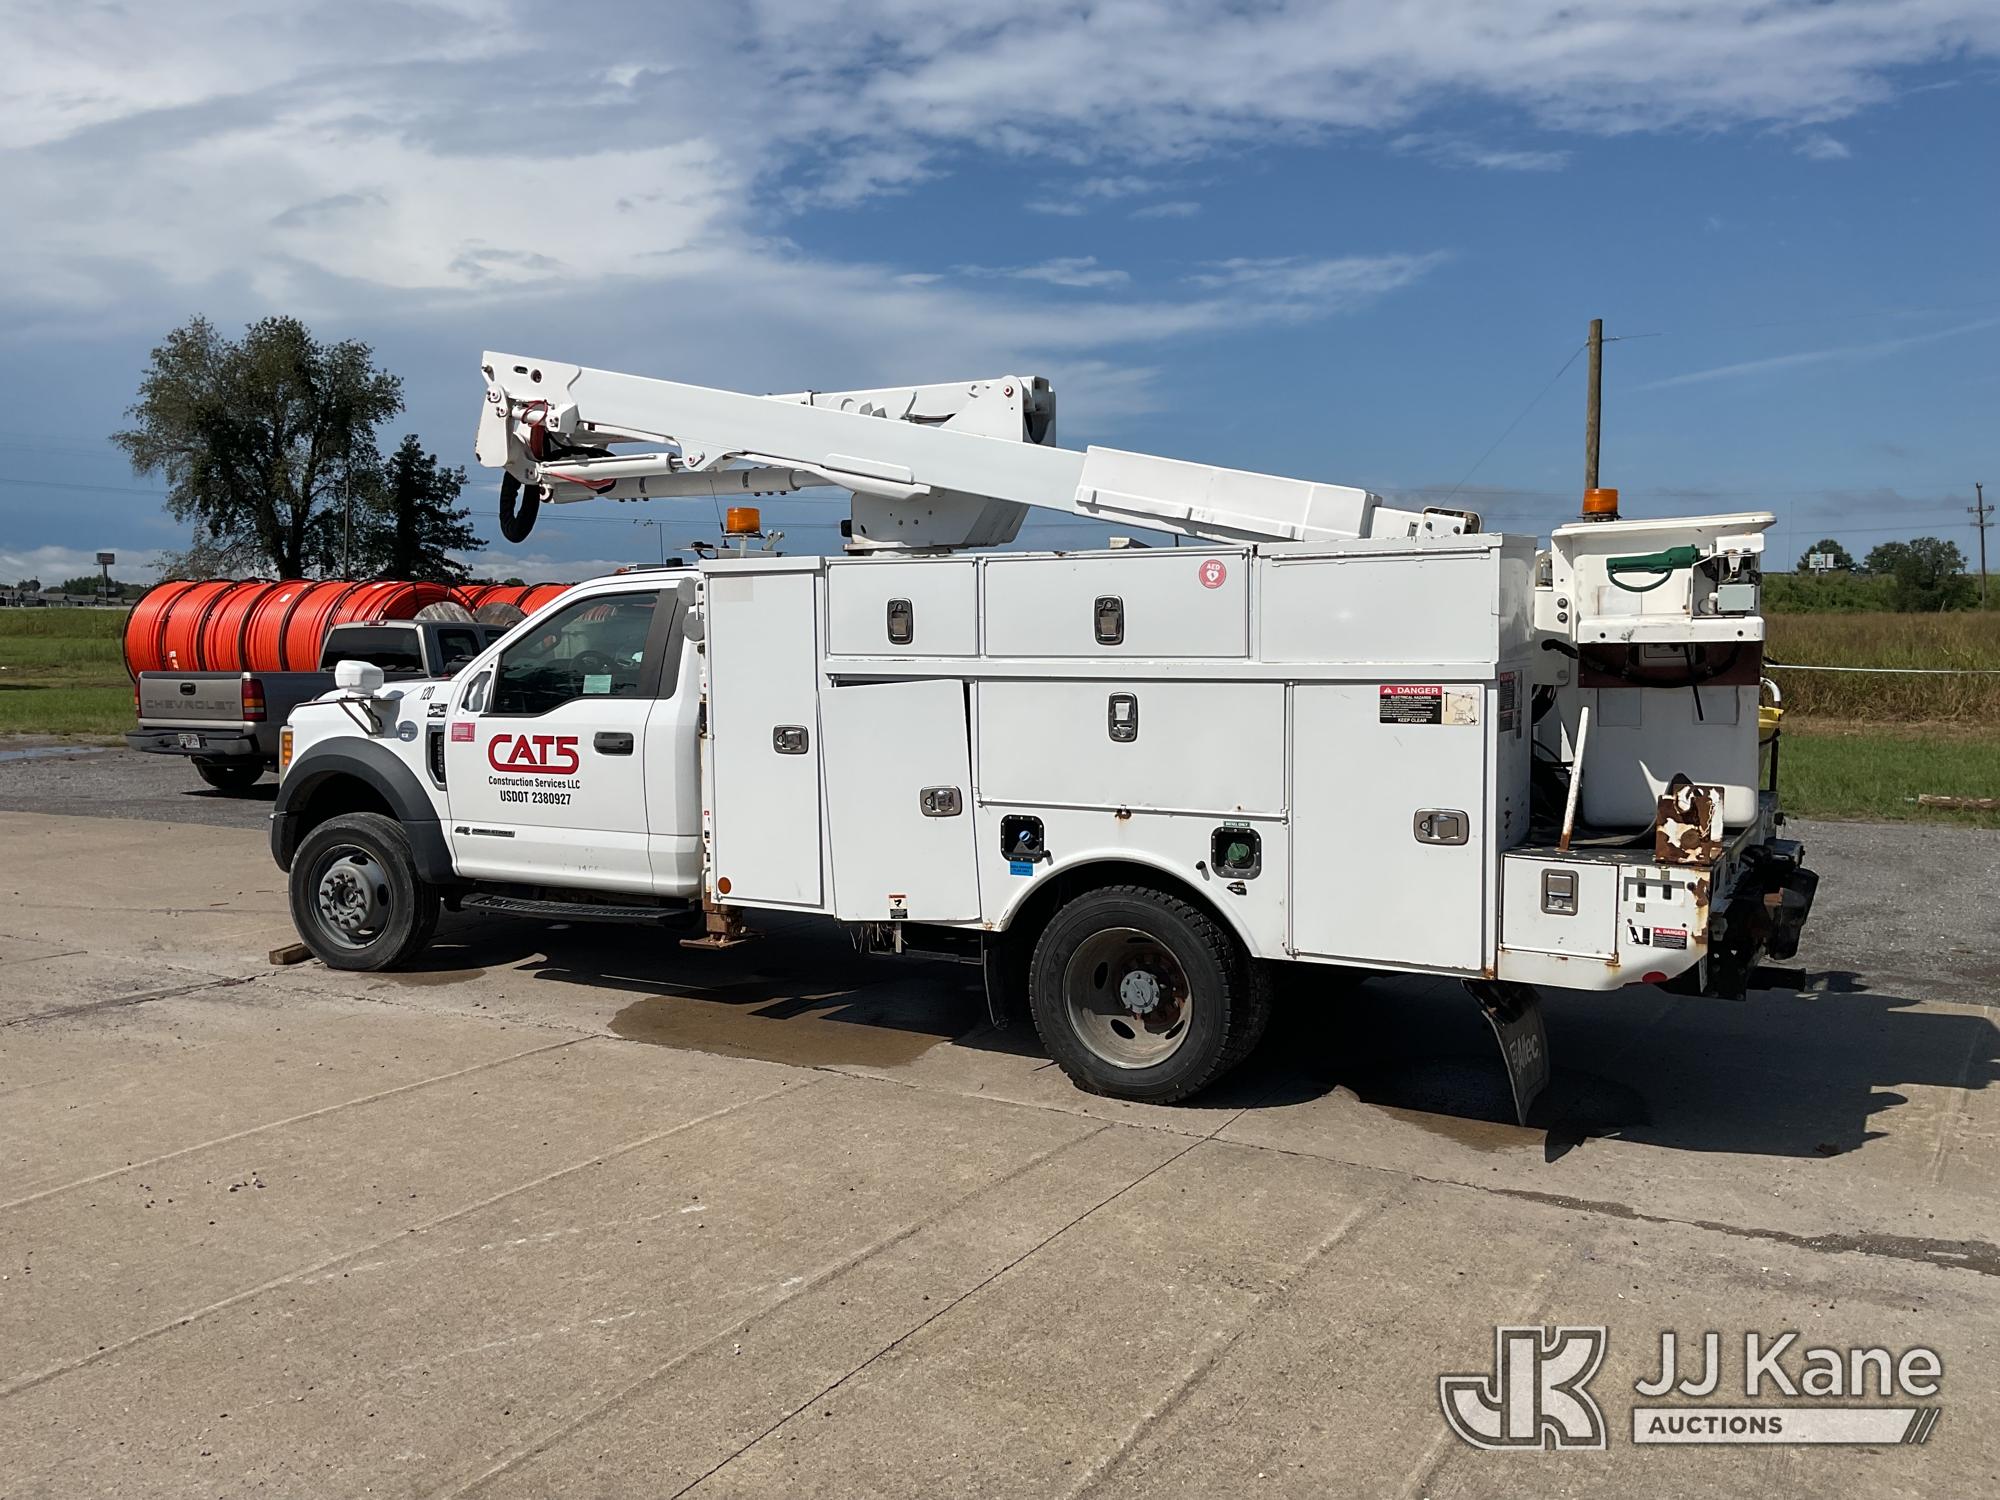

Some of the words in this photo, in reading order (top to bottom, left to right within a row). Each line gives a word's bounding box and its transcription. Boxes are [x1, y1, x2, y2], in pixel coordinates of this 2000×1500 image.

[1207, 563, 1221, 571] AED
[420, 685, 436, 700] 120
[145, 699, 236, 710] CHEVROLET
[488, 734, 580, 775] CAT5
[488, 776, 534, 787] Construction
[534, 778, 567, 788] Services
[567, 780, 581, 789] LLC
[500, 790, 529, 803] USDOT
[531, 792, 572, 805] 2380927
